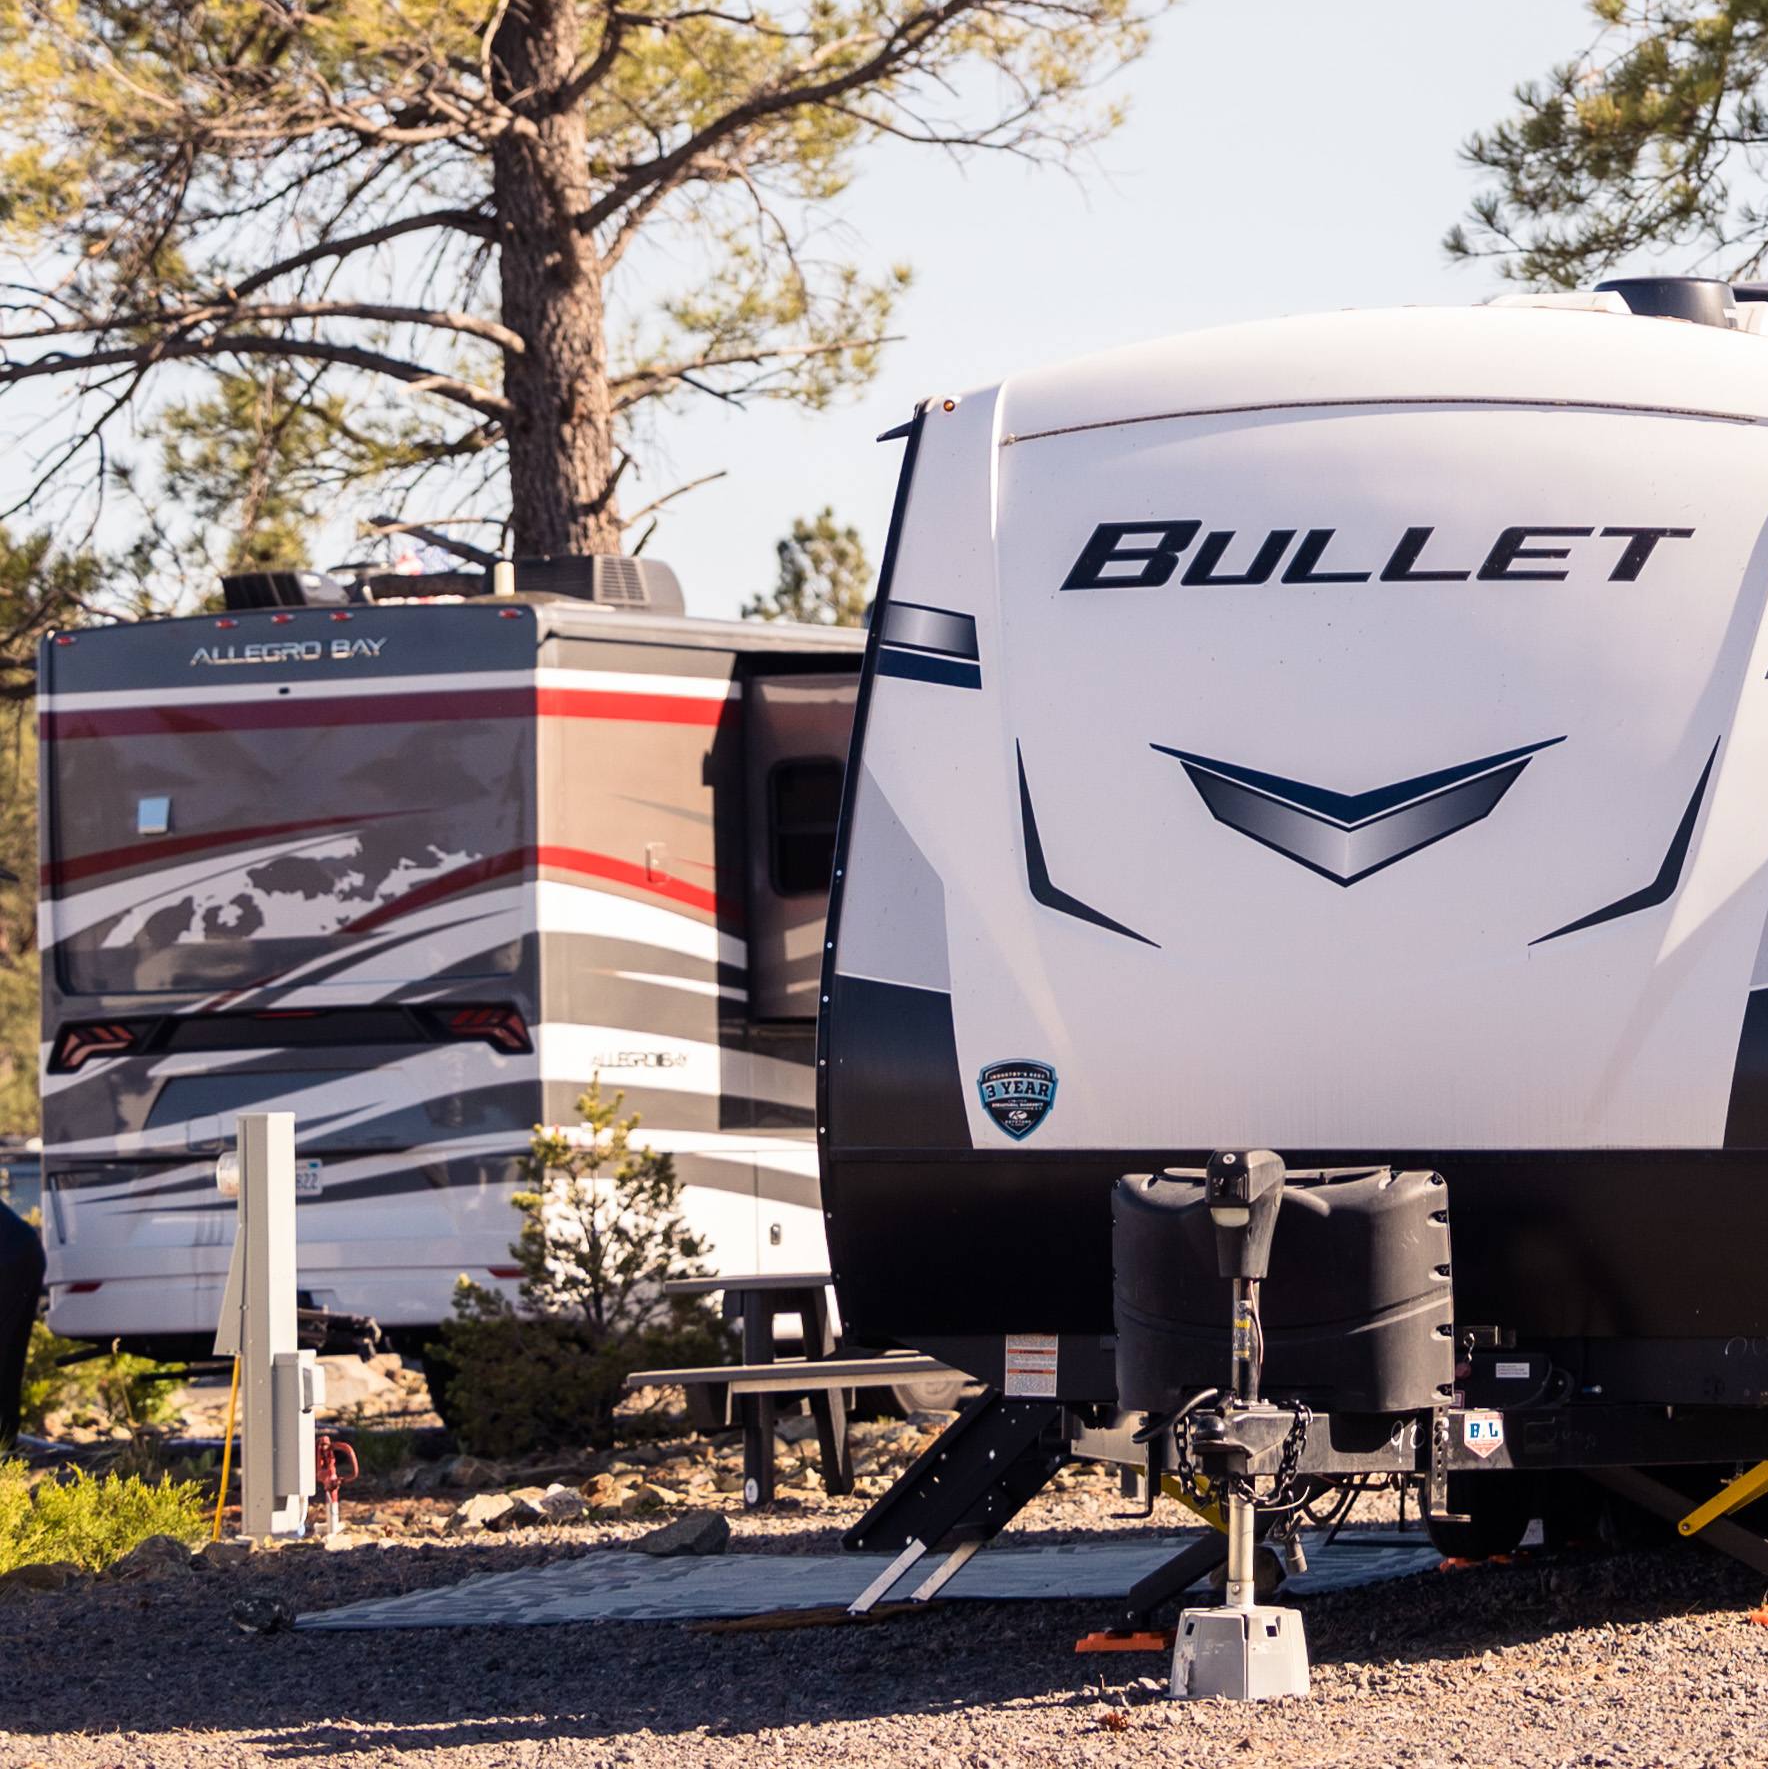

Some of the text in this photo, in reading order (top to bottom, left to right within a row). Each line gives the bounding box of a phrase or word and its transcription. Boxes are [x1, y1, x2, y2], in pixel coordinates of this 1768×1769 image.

[1059, 519, 1696, 591] BULLET
[189, 637, 388, 666] ALLEGRO BAY
[985, 1079, 1050, 1099] 3 YEAR
[1469, 1421, 1499, 1439] BL
